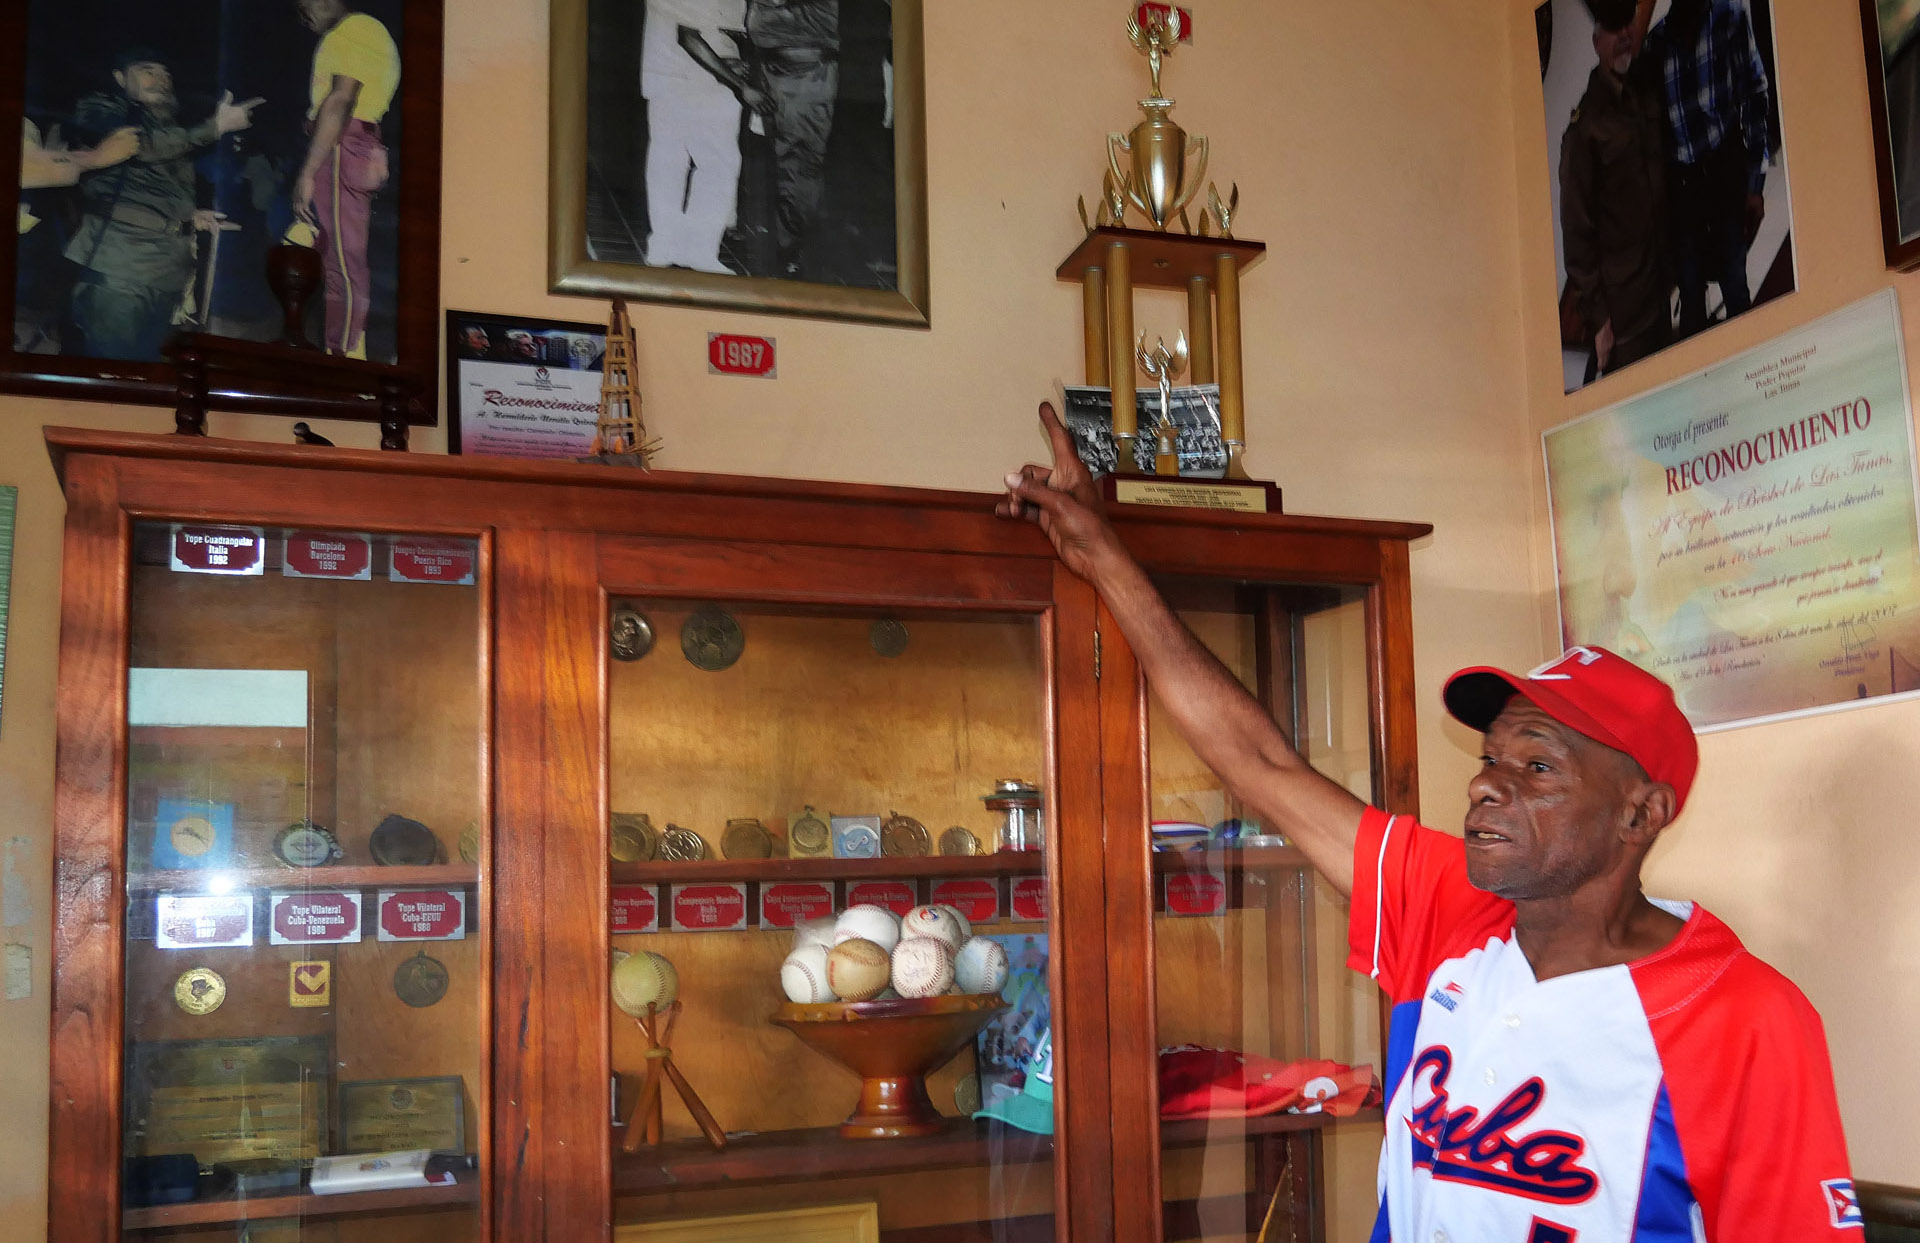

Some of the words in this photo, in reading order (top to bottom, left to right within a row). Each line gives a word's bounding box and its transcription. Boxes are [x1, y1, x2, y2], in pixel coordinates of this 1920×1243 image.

[718, 340, 764, 369] 1987
[483, 388, 601, 414] Reconocimient
[1653, 431, 1682, 452] Otorga
[1665, 396, 1872, 497] RECONOCIMIENTO
[184, 533, 203, 545] Tope
[204, 535, 254, 548] Cuadrangular
[310, 540, 346, 552] Olimpiada
[208, 544, 229, 555] Italia
[310, 550, 346, 561] Barcelona
[208, 554, 229, 565] 1992
[319, 560, 337, 571] 1992
[291, 905, 310, 917] Tope
[311, 904, 342, 915] Vilateral
[397, 902, 416, 914] Tope
[416, 902, 446, 912] Vilateral
[287, 914, 345, 925] Cuba-Venezuela
[402, 912, 442, 922] Cuba-EEUU
[1404, 1044, 1598, 1205] Cuba
